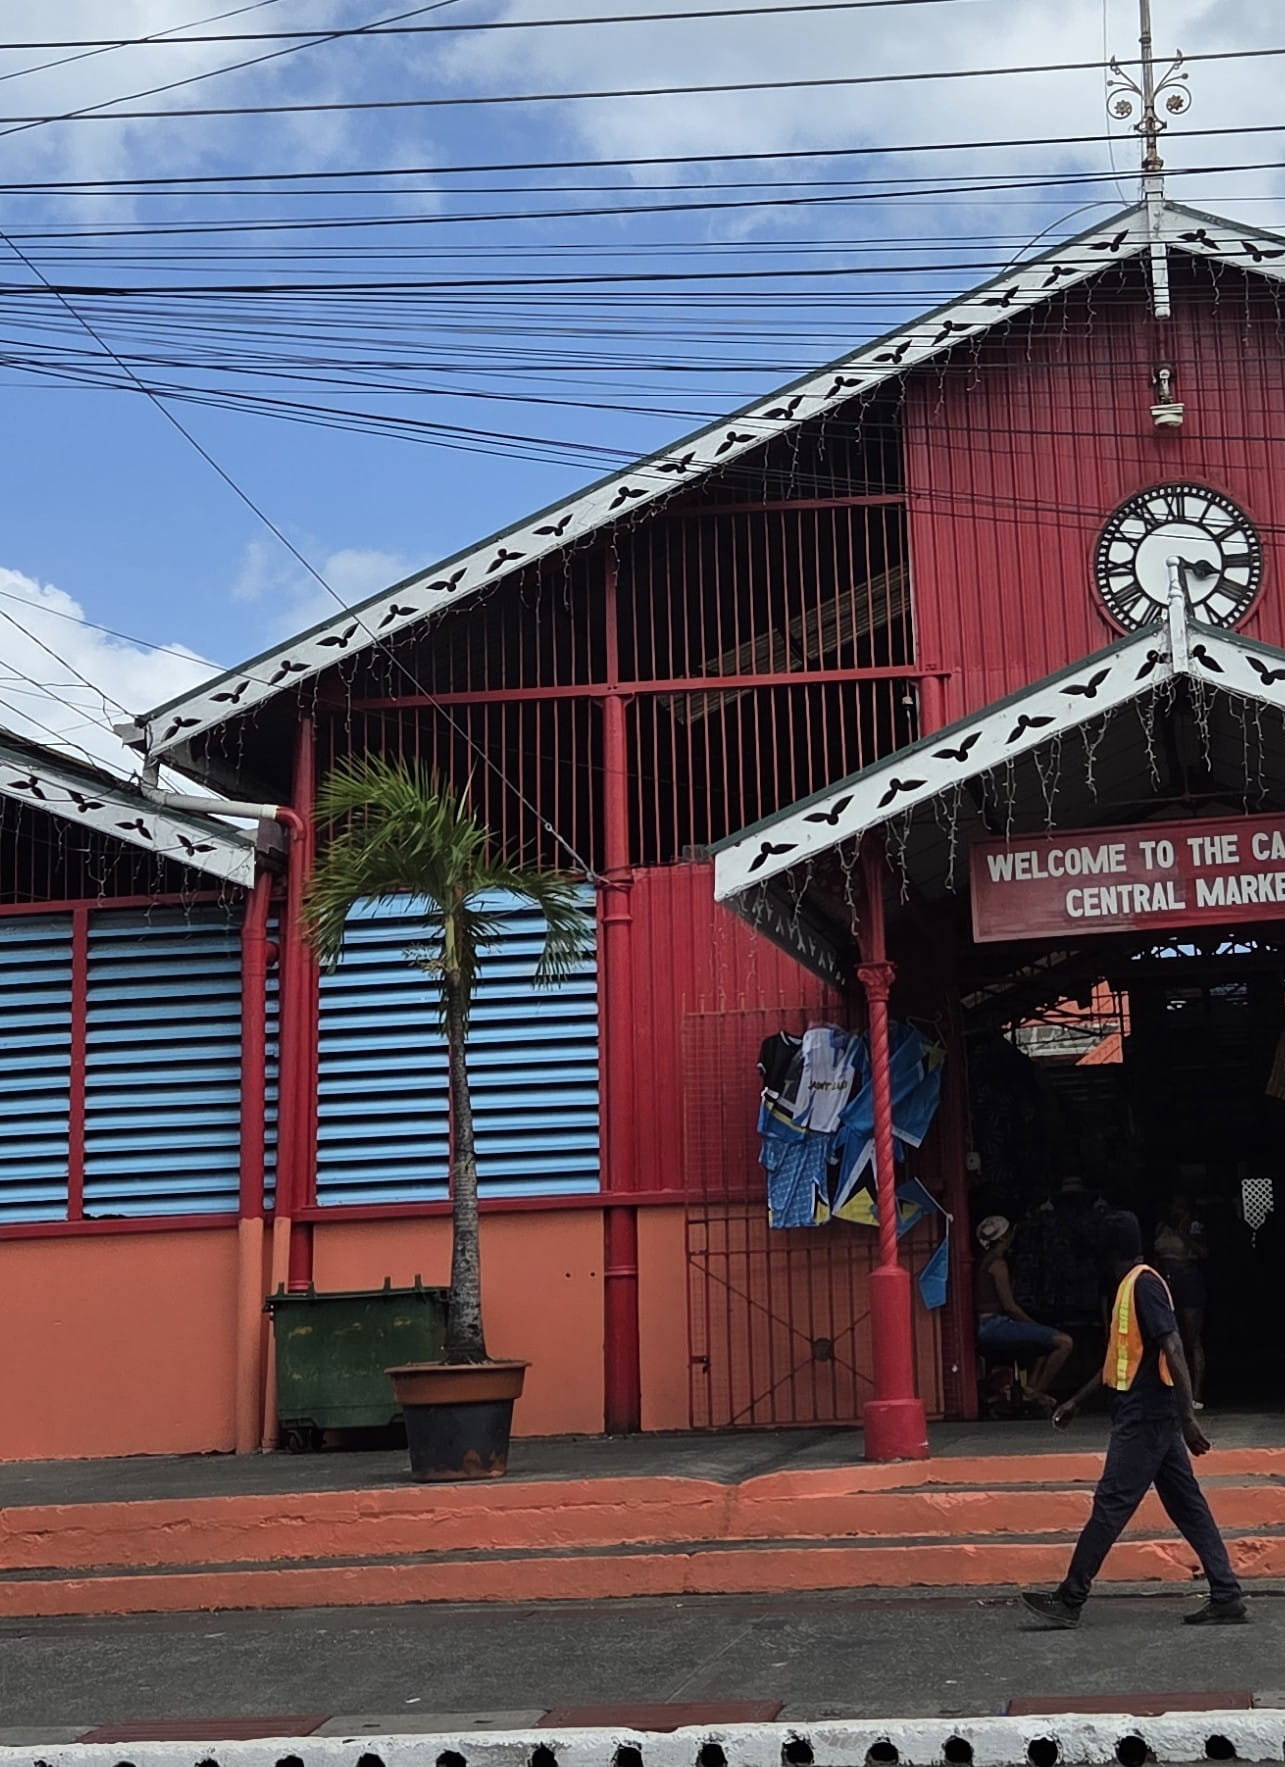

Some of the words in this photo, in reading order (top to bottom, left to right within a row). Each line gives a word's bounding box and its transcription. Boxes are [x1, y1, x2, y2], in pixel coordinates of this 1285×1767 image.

[987, 844, 1127, 882] WELCOME
[1139, 840, 1174, 870] TO
[1187, 834, 1240, 867] THE
[1066, 881, 1186, 918] CENTRAL
